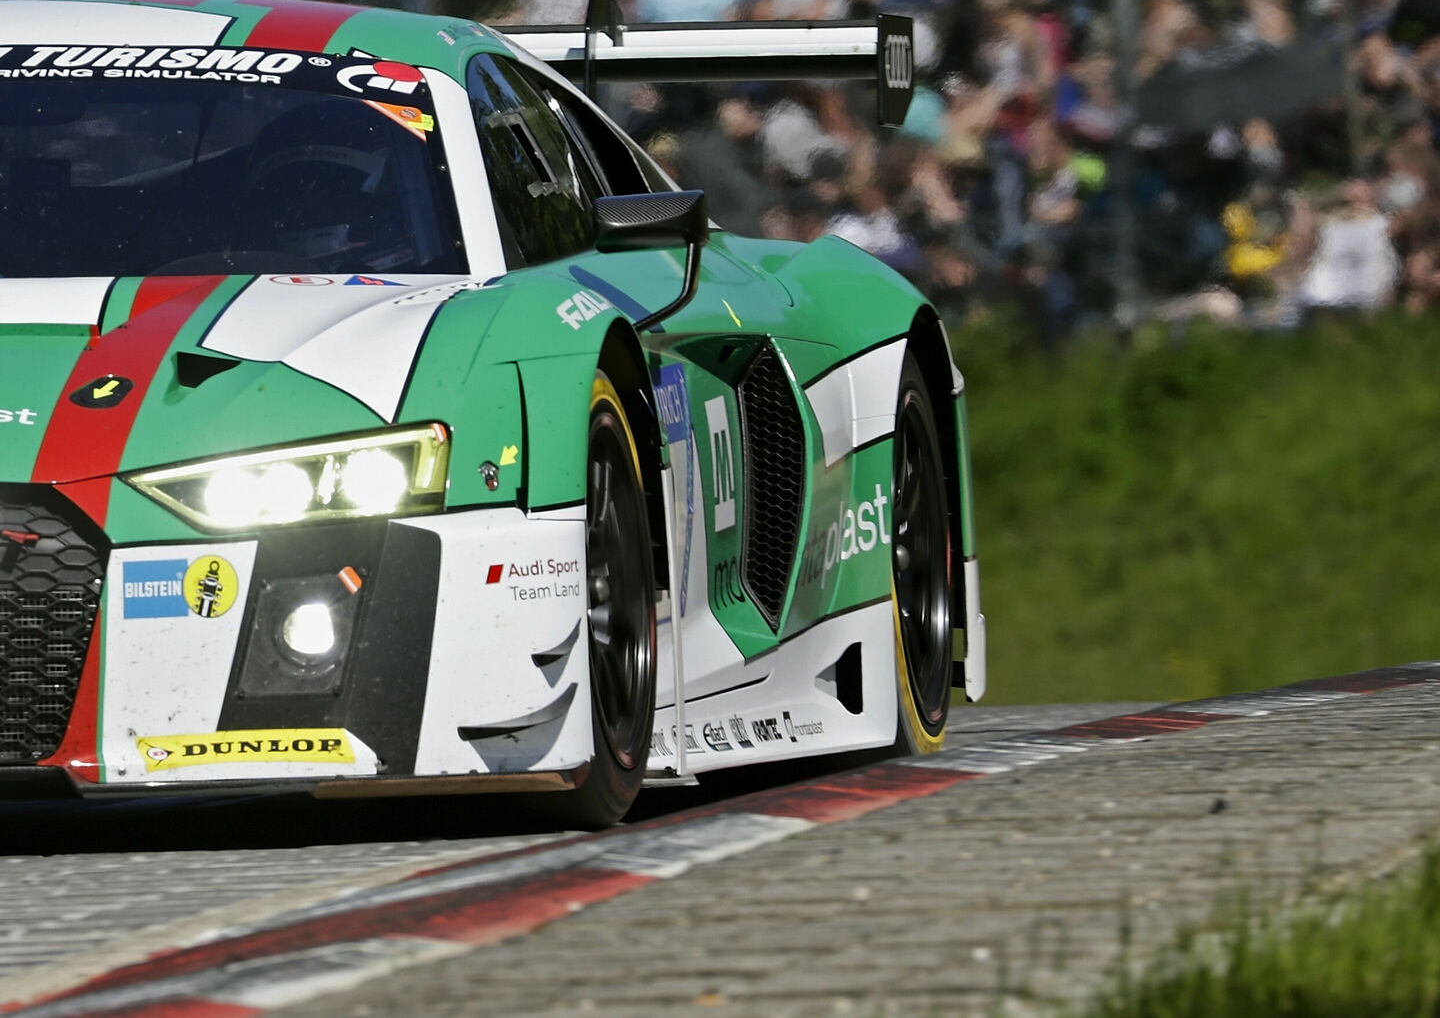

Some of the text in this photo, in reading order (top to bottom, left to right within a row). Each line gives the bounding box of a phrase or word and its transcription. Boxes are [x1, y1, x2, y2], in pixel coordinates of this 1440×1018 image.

[22, 46, 302, 74] TURISMO
[103, 68, 282, 84] SIMULATOR
[508, 558, 579, 578] Audi Sport
[124, 581, 182, 598] BILSTEIN
[509, 582, 580, 601] Team Land
[182, 738, 343, 757] DUNLOP
